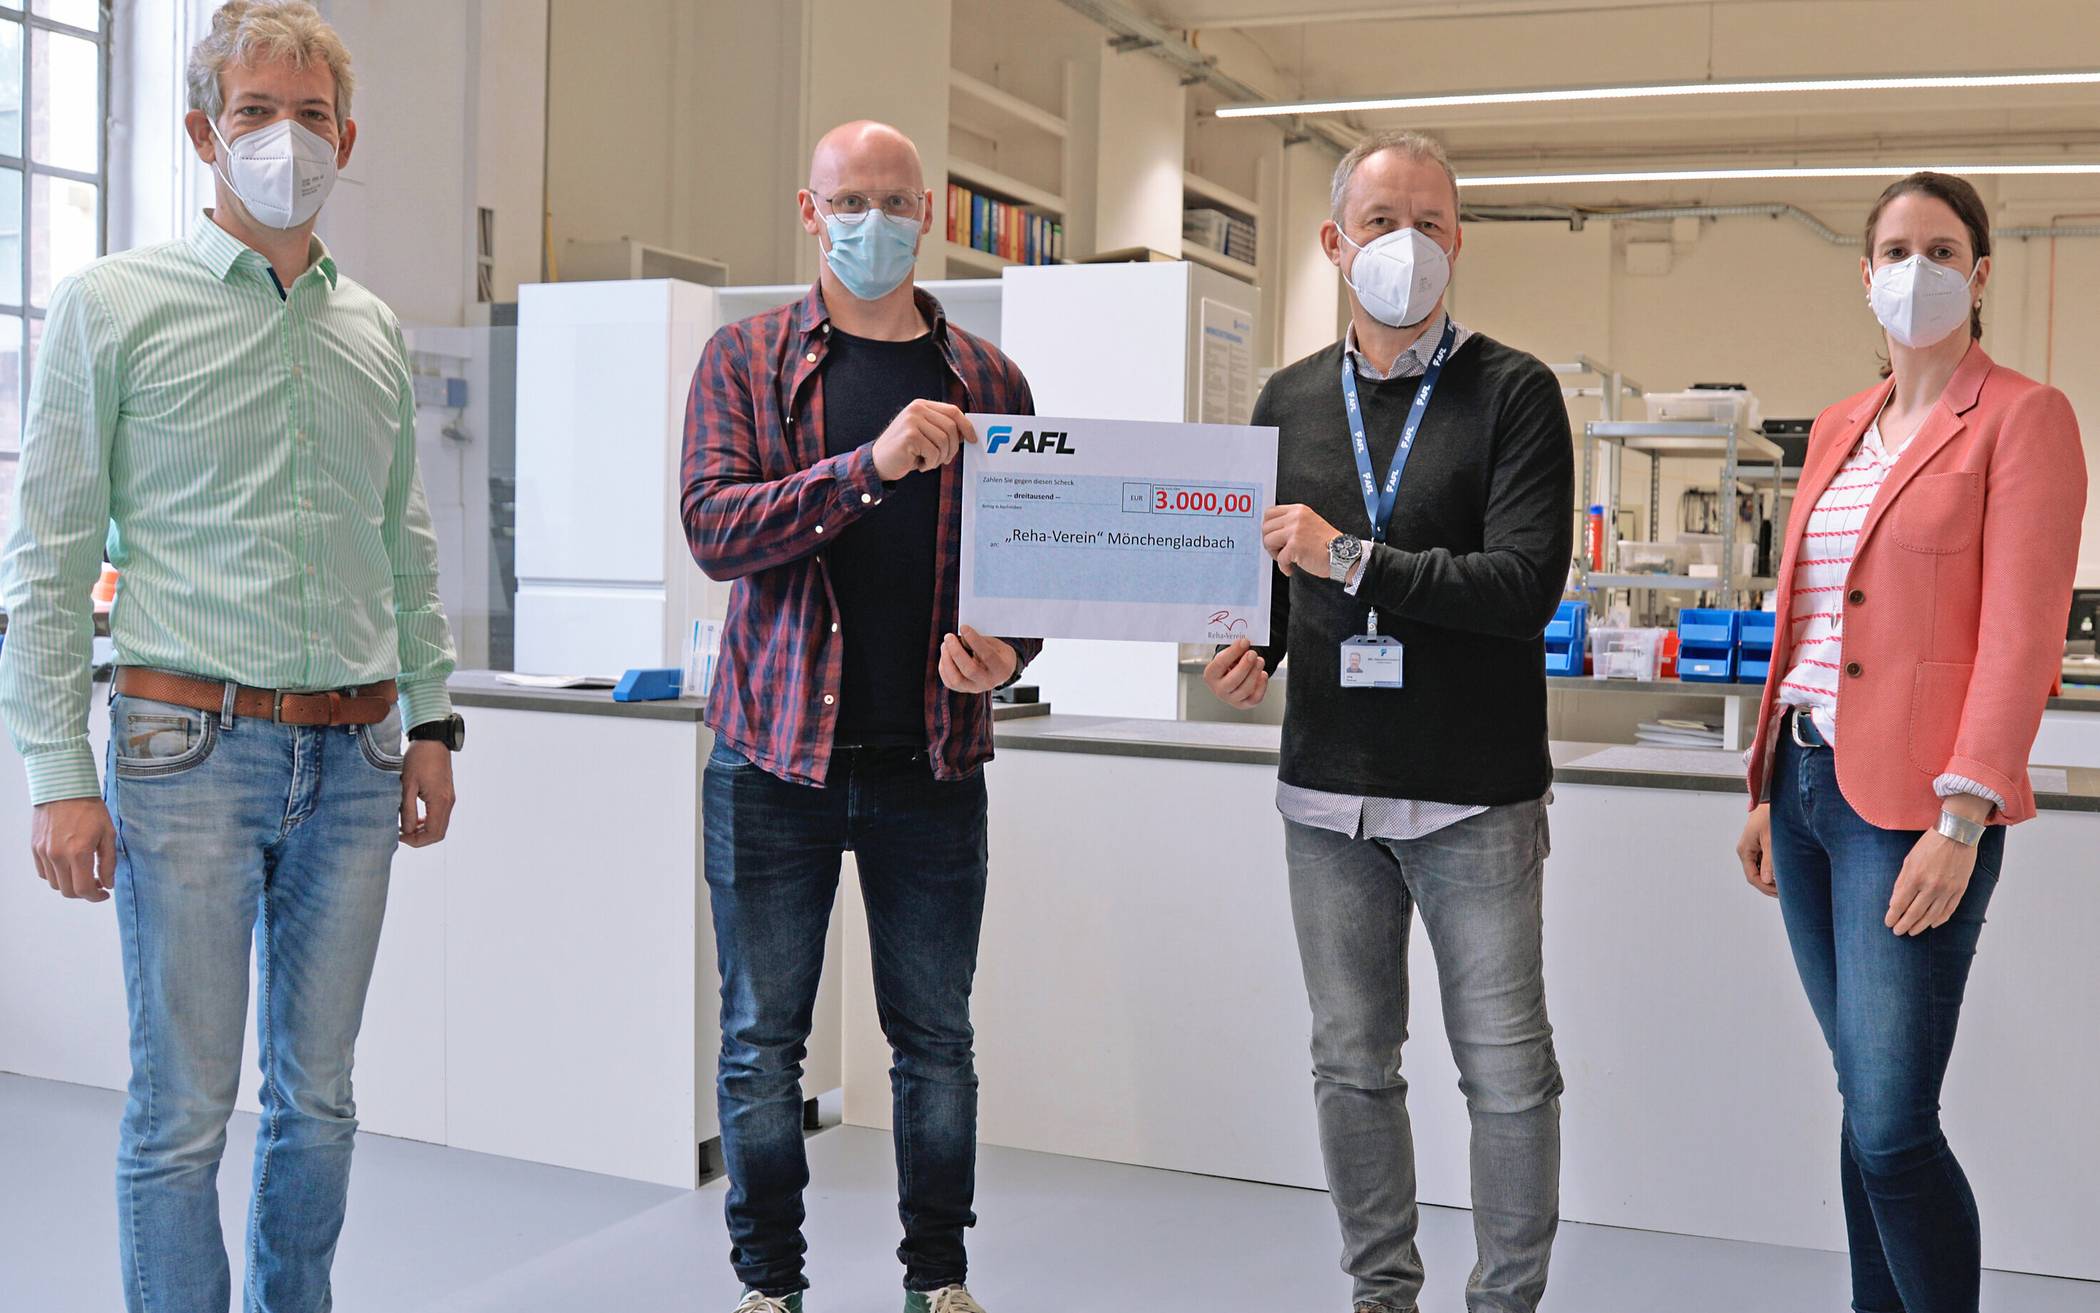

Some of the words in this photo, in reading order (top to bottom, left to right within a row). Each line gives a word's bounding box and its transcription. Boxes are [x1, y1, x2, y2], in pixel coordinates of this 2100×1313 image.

[1011, 430, 1076, 455] AFL
[983, 476, 1003, 484] Zahlen
[1013, 492, 1054, 500] dreitausend
[1130, 494, 1143, 502] EUR
[1155, 490, 1252, 515] 3.000,00
[1108, 531, 1235, 550] Mönchengladbach
